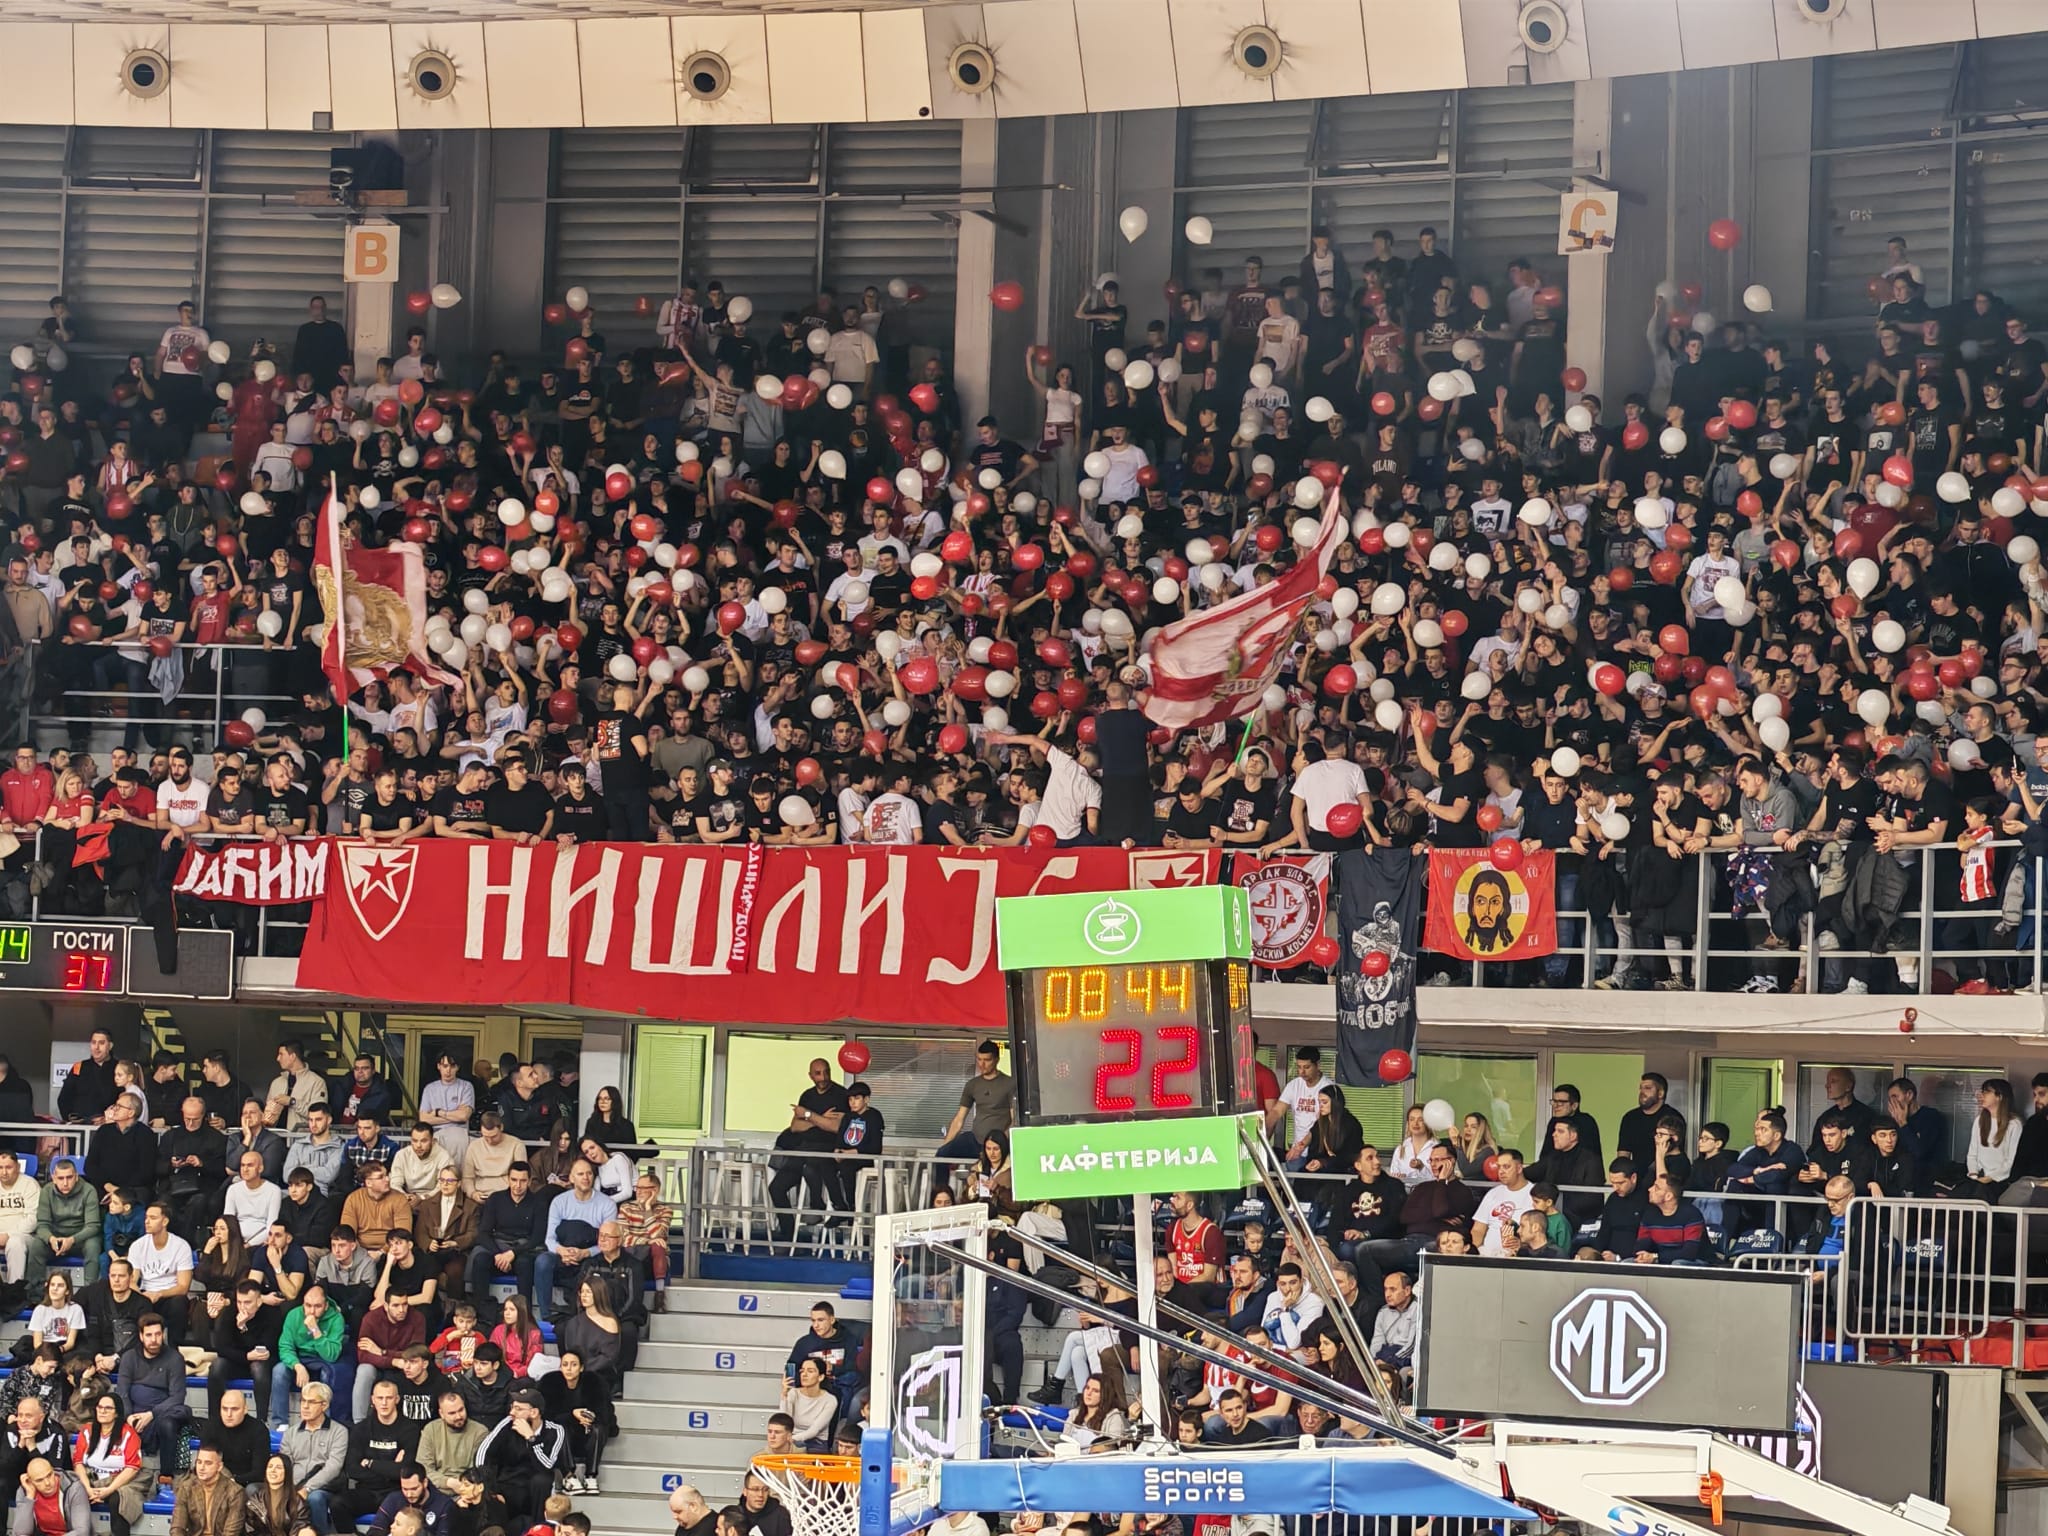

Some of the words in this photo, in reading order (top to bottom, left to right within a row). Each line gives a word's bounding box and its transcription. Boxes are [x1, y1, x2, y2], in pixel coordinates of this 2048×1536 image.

[1570, 199, 1606, 247] C
[355, 231, 387, 275] B
[53, 931, 114, 951] ГОСТИ
[66, 955, 110, 988] 37
[1096, 1026, 1199, 1110] 22
[1040, 1145, 1218, 1173] КАФЕТЕРИЈА
[742, 1296, 754, 1310] 7
[1560, 1299, 1656, 1395] MG
[719, 1354, 732, 1368] 6
[693, 1412, 705, 1427] 5
[665, 1476, 679, 1491] 4
[1144, 1467, 1244, 1484] Schelde
[1144, 1485, 1246, 1507] Sports
